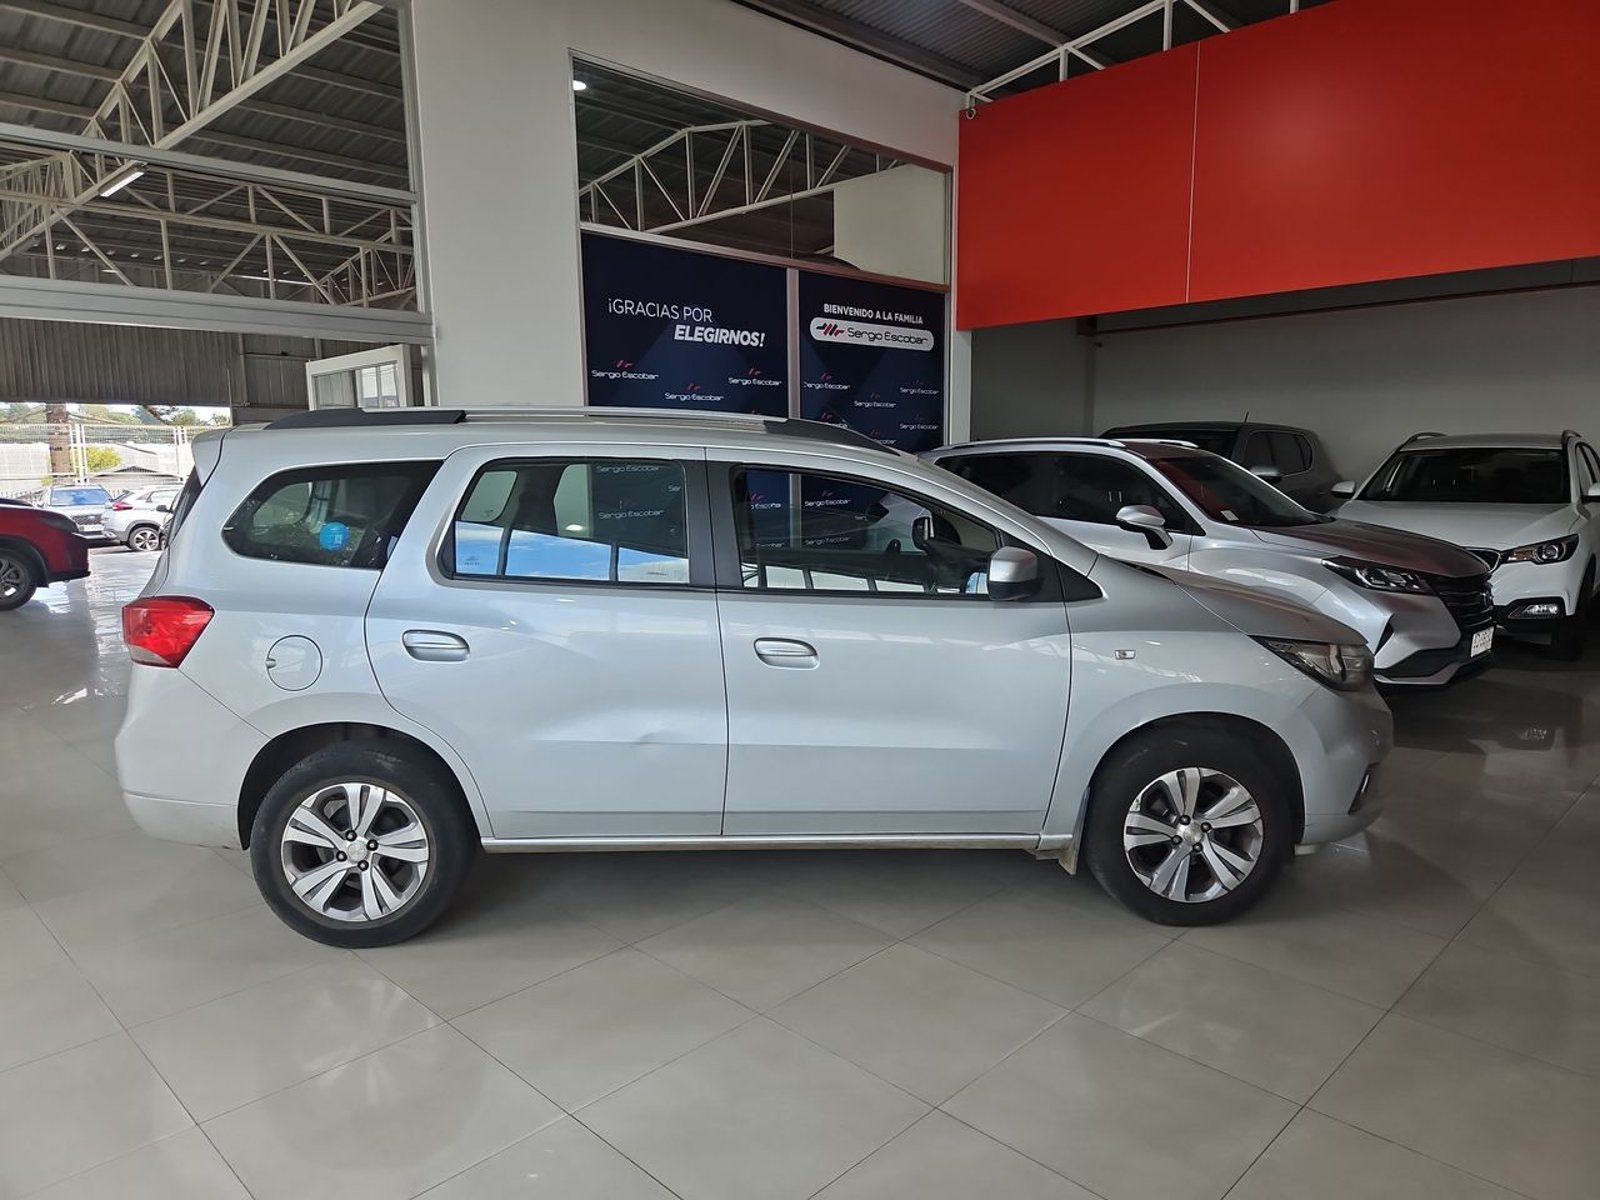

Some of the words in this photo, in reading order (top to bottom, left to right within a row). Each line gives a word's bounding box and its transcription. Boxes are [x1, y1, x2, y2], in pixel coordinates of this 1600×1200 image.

[608, 298, 680, 320] ¡GRACIAS
[683, 306, 713, 323] POR
[823, 303, 874, 319] BIENVENIDO
[875, 310, 881, 320] A
[882, 311, 893, 321] LA
[894, 312, 924, 325] FAMILIA
[673, 324, 766, 348] ELEGIRNOS!
[846, 326, 883, 342] Sergo
[884, 331, 929, 345] Escobar
[591, 369, 621, 380] Sergo
[622, 370, 660, 380] Escobar
[728, 376, 752, 386] Sergo
[752, 378, 782, 387] Escobar
[664, 392, 691, 401] Sergo
[691, 393, 725, 402] Escobar
